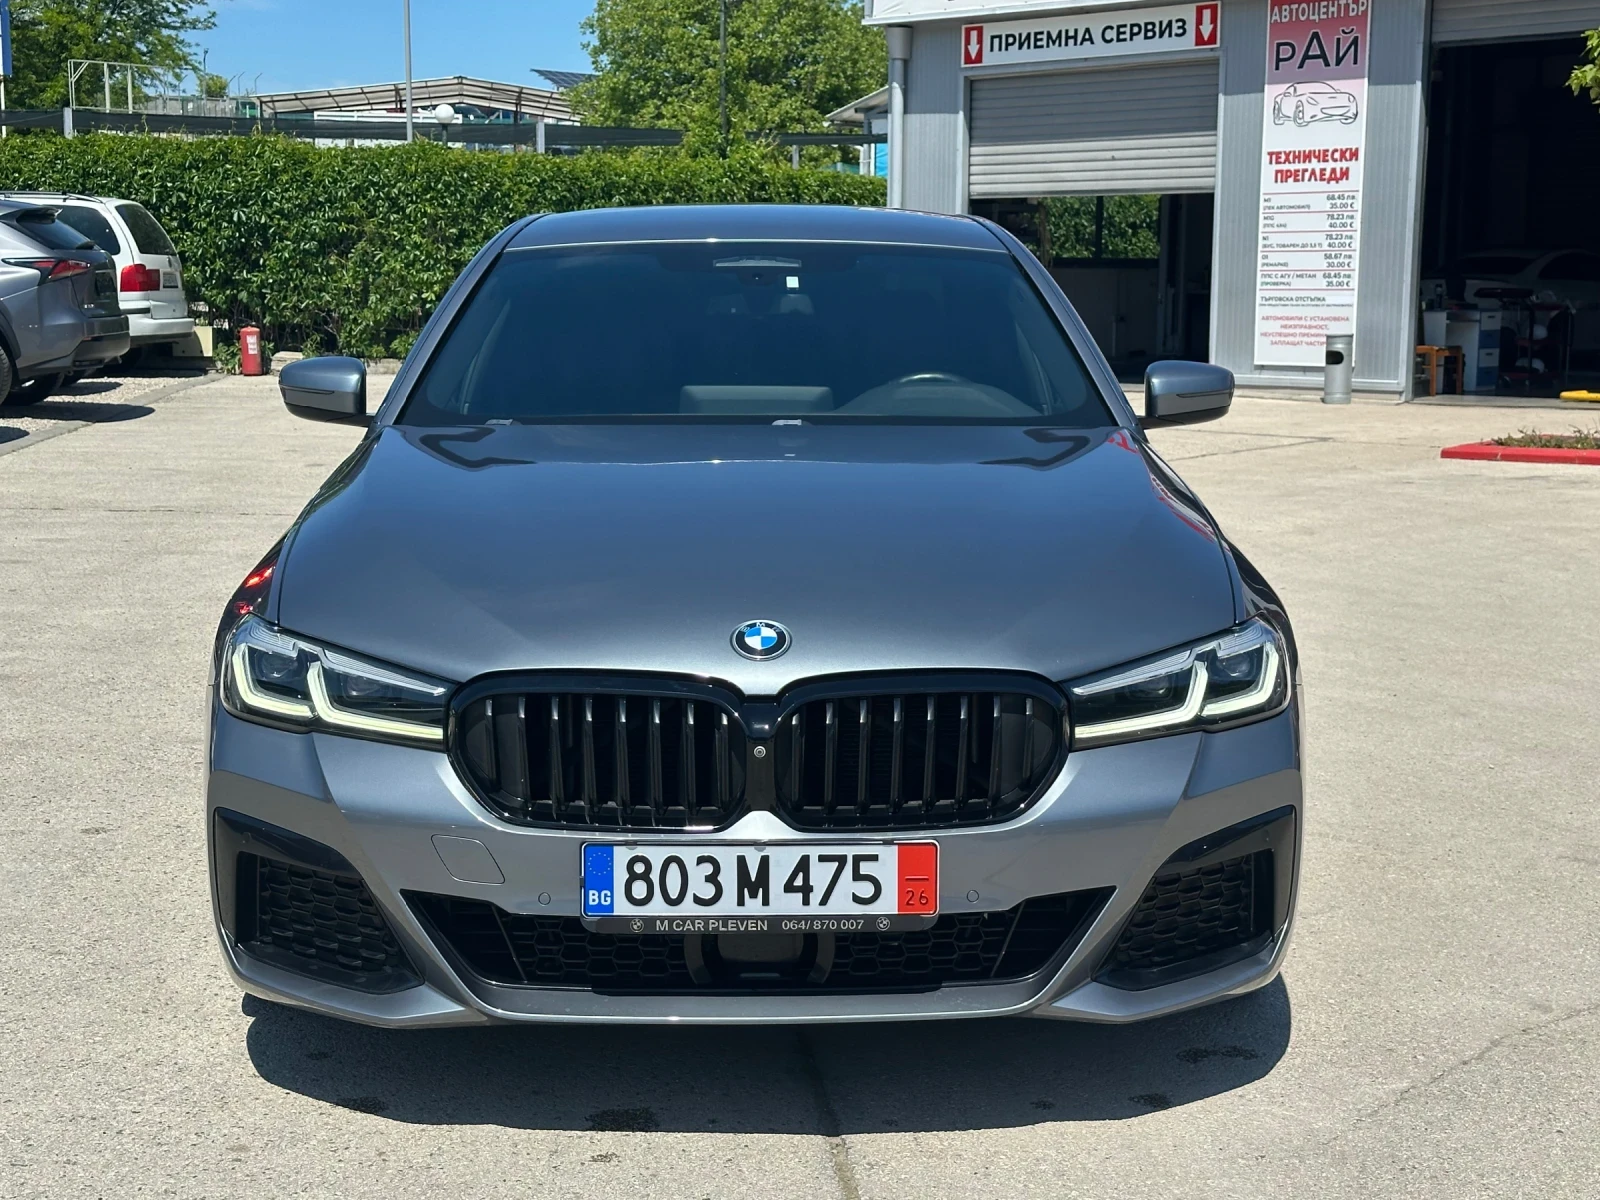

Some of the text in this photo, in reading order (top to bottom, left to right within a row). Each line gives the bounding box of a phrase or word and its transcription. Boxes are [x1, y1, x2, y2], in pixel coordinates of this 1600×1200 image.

[1271, 0, 1367, 23] АВТОЦЕНТЪР
[989, 18, 1187, 52] ПРИЕМНА СЕРВИЗ
[1274, 27, 1360, 71] РАЙ
[1267, 147, 1359, 165] ТЕХНИЧЕСКИ
[1274, 167, 1349, 184] ПРЕГЛЕДИ
[624, 854, 883, 907] 803 M 475
[588, 890, 611, 905] BG
[905, 888, 929, 906] 26
[656, 920, 864, 931] M CAR PLEVEN 064/ 870 007
